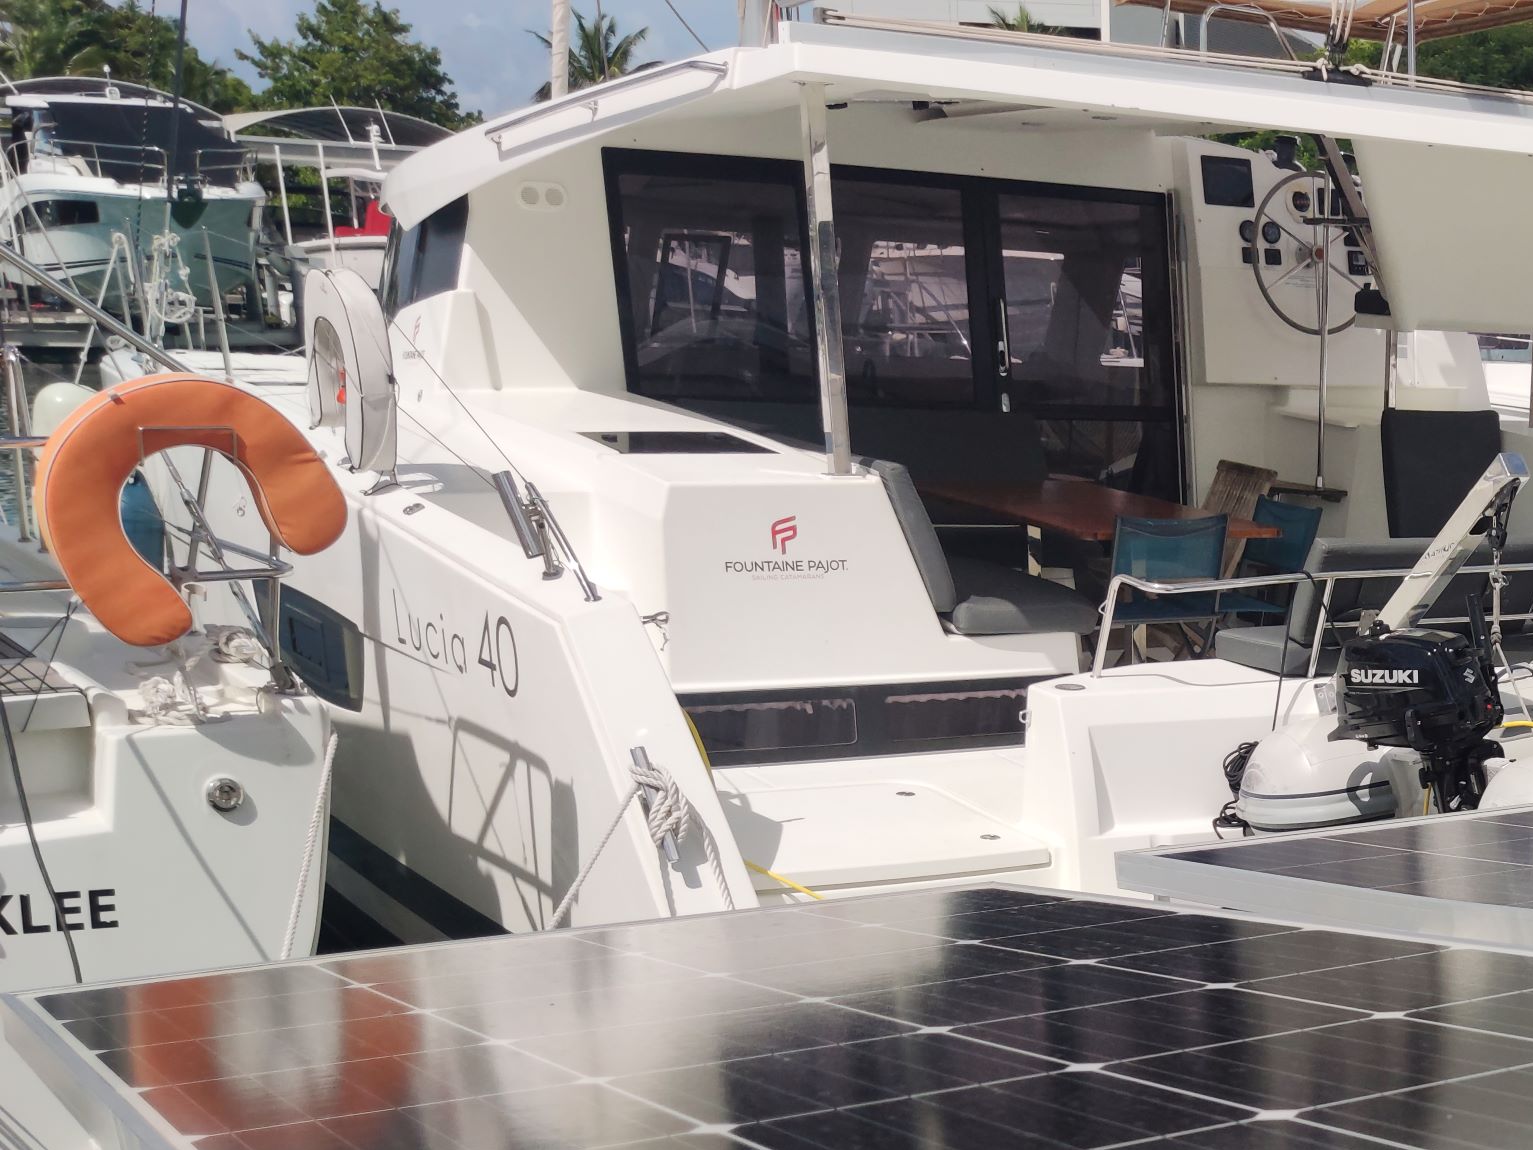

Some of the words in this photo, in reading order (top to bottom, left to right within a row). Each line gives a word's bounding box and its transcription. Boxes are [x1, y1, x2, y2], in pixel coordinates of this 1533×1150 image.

[725, 560, 804, 573] FOUNTAINE
[393, 588, 467, 674] Lucia
[478, 610, 519, 698] 40
[1350, 669, 1419, 684] SUZUKI
